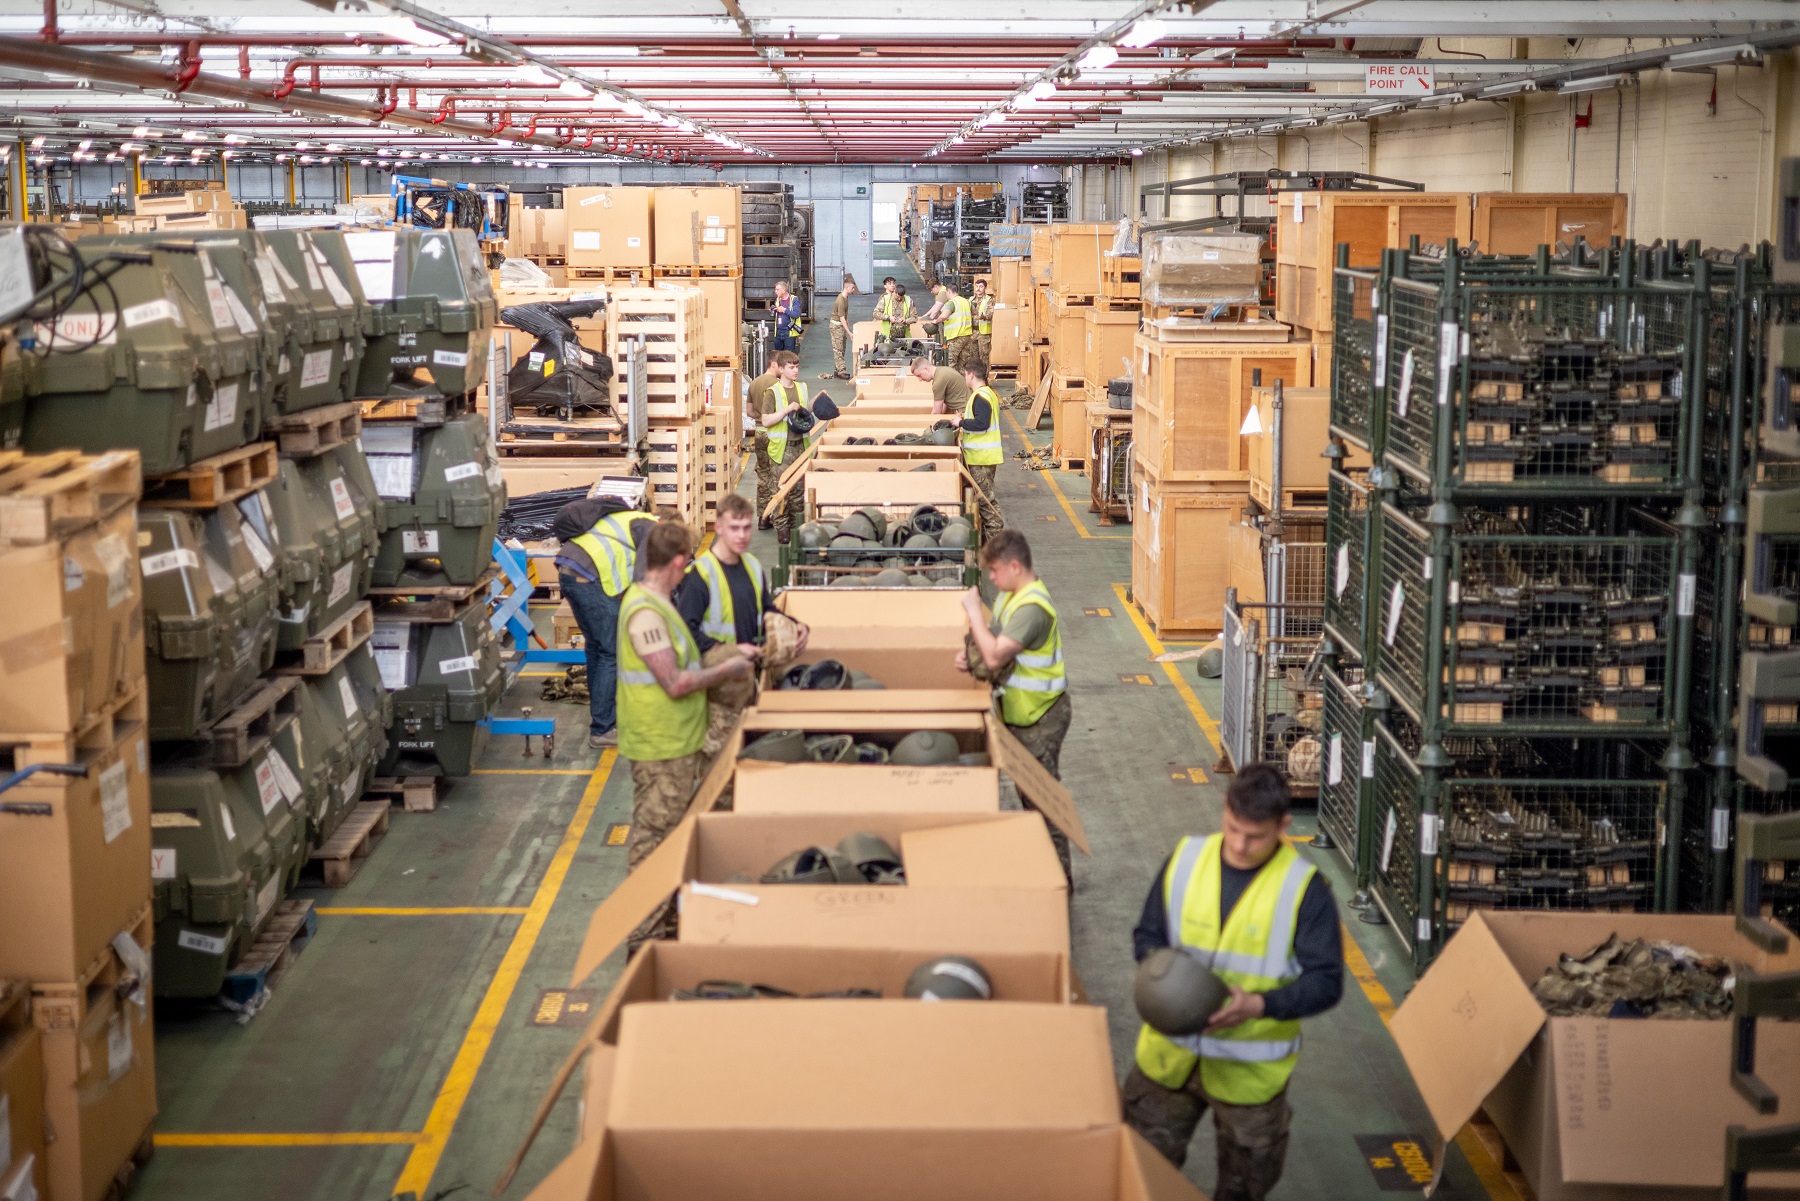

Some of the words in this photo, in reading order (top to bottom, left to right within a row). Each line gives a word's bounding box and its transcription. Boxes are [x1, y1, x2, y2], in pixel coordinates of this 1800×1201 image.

[1369, 66, 1395, 75] FIRE
[1400, 66, 1430, 75] CALL
[1369, 80, 1404, 89] POINT
[390, 356, 411, 364] FORK
[412, 355, 428, 363] LIFT
